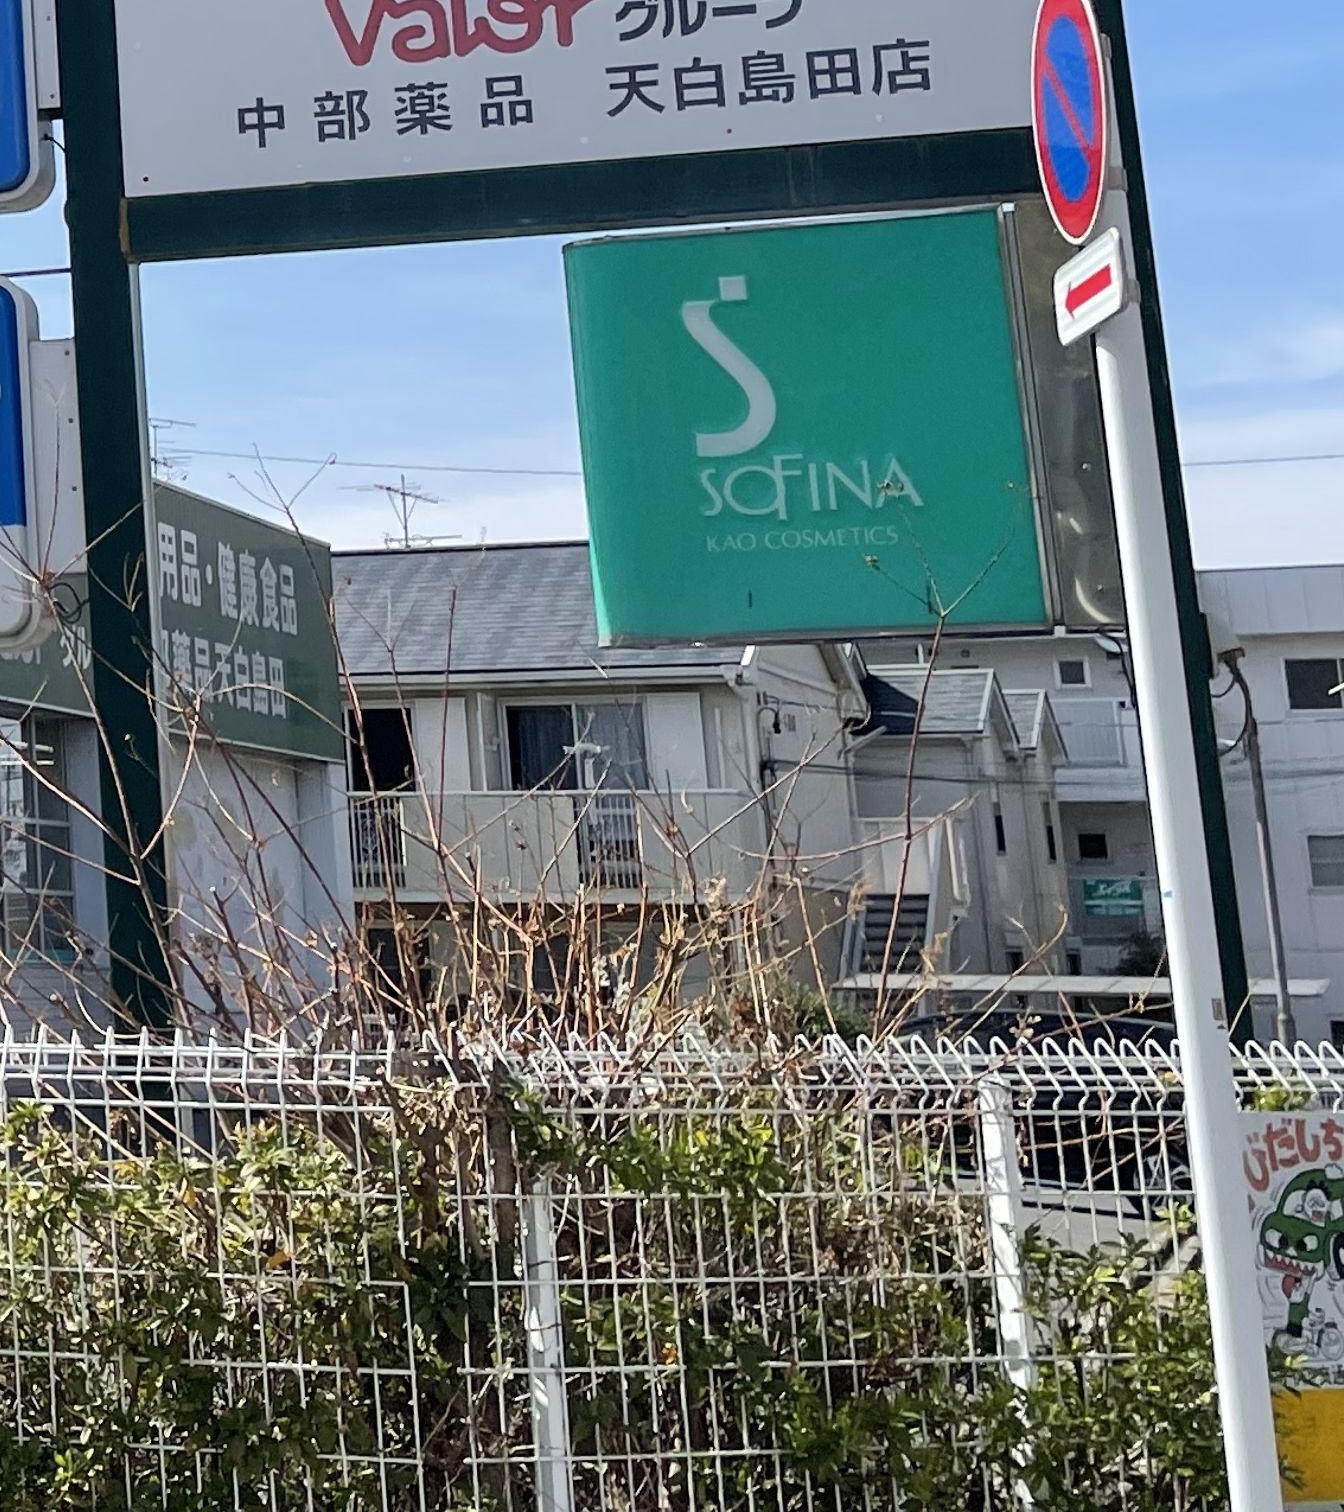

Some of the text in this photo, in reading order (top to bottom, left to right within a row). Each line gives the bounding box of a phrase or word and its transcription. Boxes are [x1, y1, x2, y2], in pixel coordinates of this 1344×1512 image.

[604, 37, 933, 118] 天白島田店
[700, 452, 924, 521] SOFINA
[707, 525, 899, 552] KAO COSMETICS
